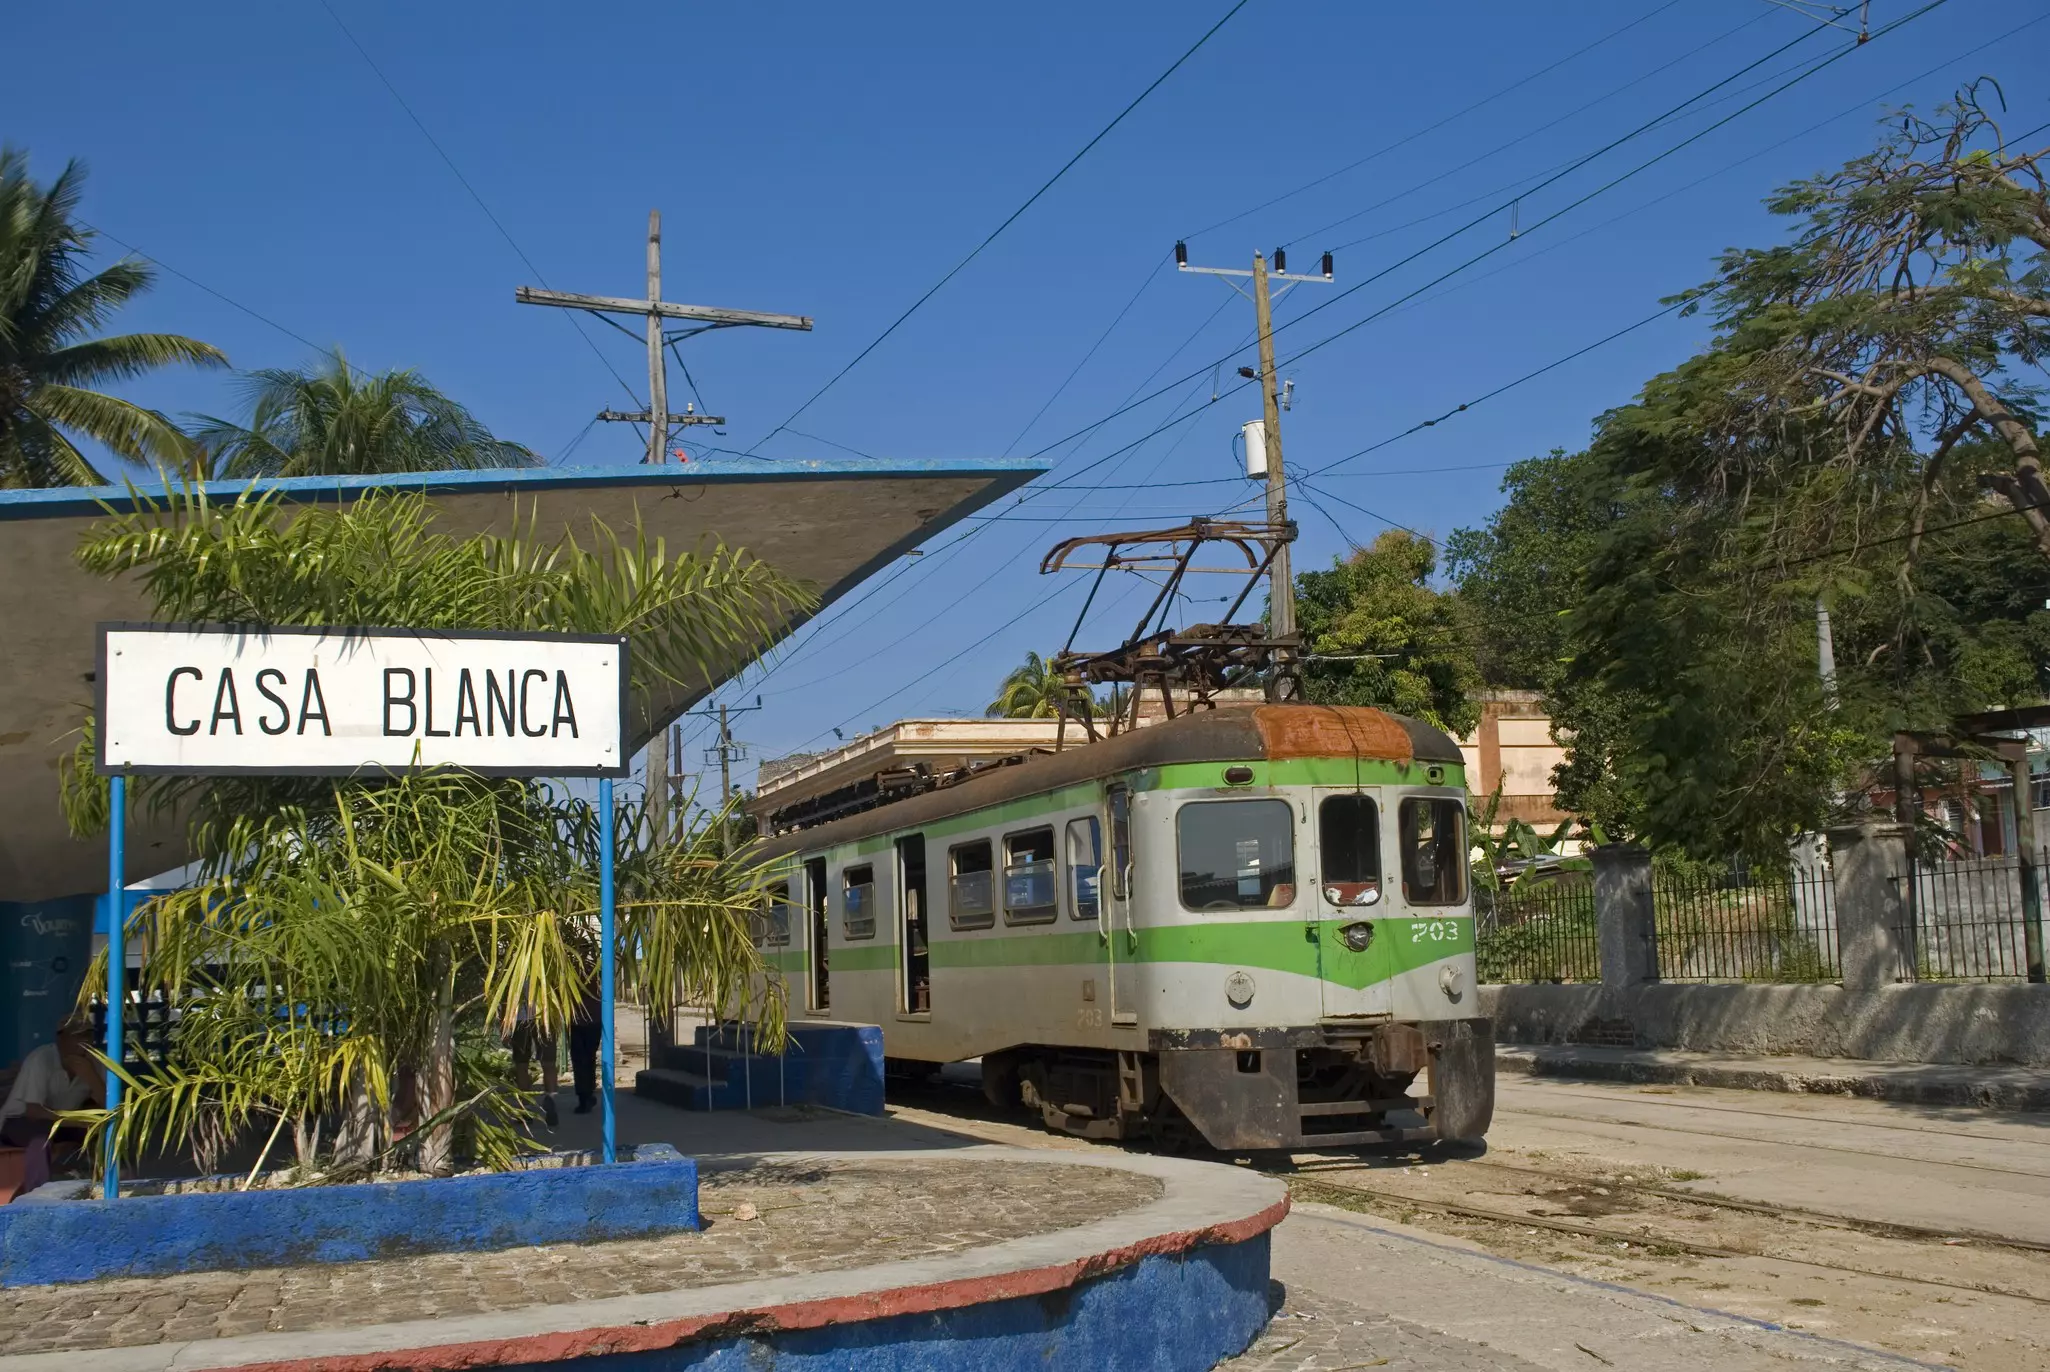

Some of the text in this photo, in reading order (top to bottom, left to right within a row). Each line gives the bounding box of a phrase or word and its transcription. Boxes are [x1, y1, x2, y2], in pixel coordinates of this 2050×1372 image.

[166, 666, 579, 738] CASA BLANCA
[1411, 921, 1459, 943] 703
